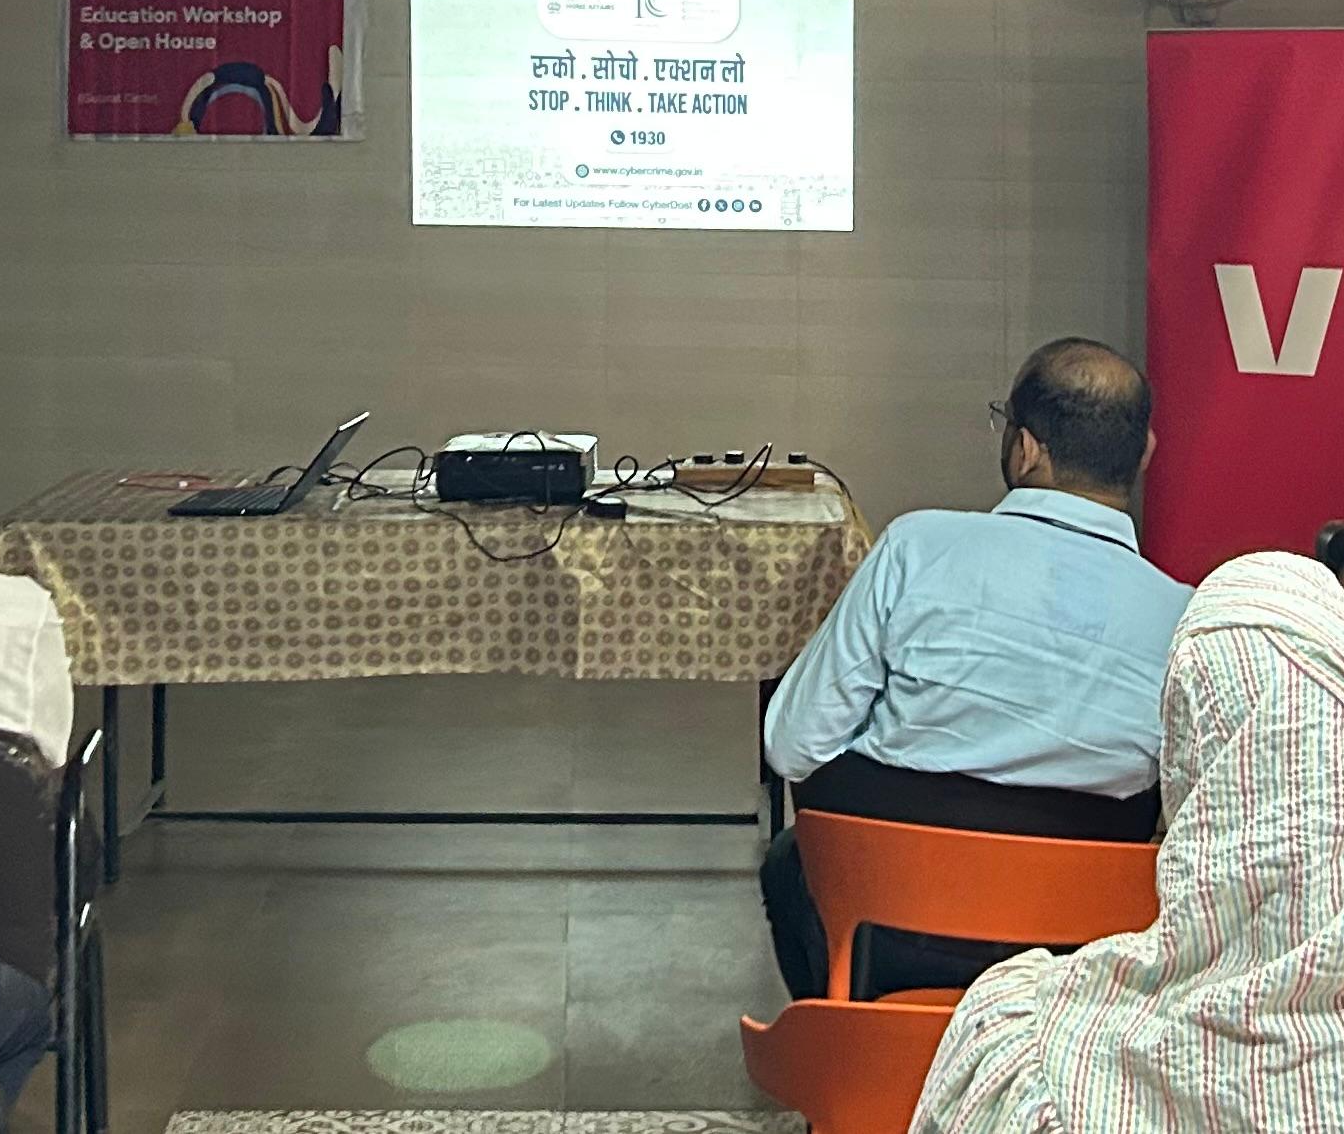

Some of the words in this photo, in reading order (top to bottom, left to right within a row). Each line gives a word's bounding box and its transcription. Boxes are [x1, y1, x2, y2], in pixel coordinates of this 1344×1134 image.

[80, 7, 177, 23] Education
[183, 6, 282, 28] Workshop
[79, 33, 94, 49] &
[98, 33, 150, 53] Open
[156, 33, 217, 49] House
[530, 48, 576, 80] रुको
[591, 49, 638, 81] सोचो
[654, 58, 717, 82] एक्शन
[720, 52, 745, 83] लो
[528, 89, 570, 111] STOP
[585, 91, 632, 112] THINK
[648, 92, 688, 114] TAKE
[692, 94, 748, 115] ACTION
[630, 130, 666, 145] 1930
[592, 166, 703, 178] www.cybercrime.gov.in
[513, 197, 529, 208] For
[532, 198, 562, 208] Latest
[565, 199, 606, 210] Updates
[608, 199, 639, 209] Follow
